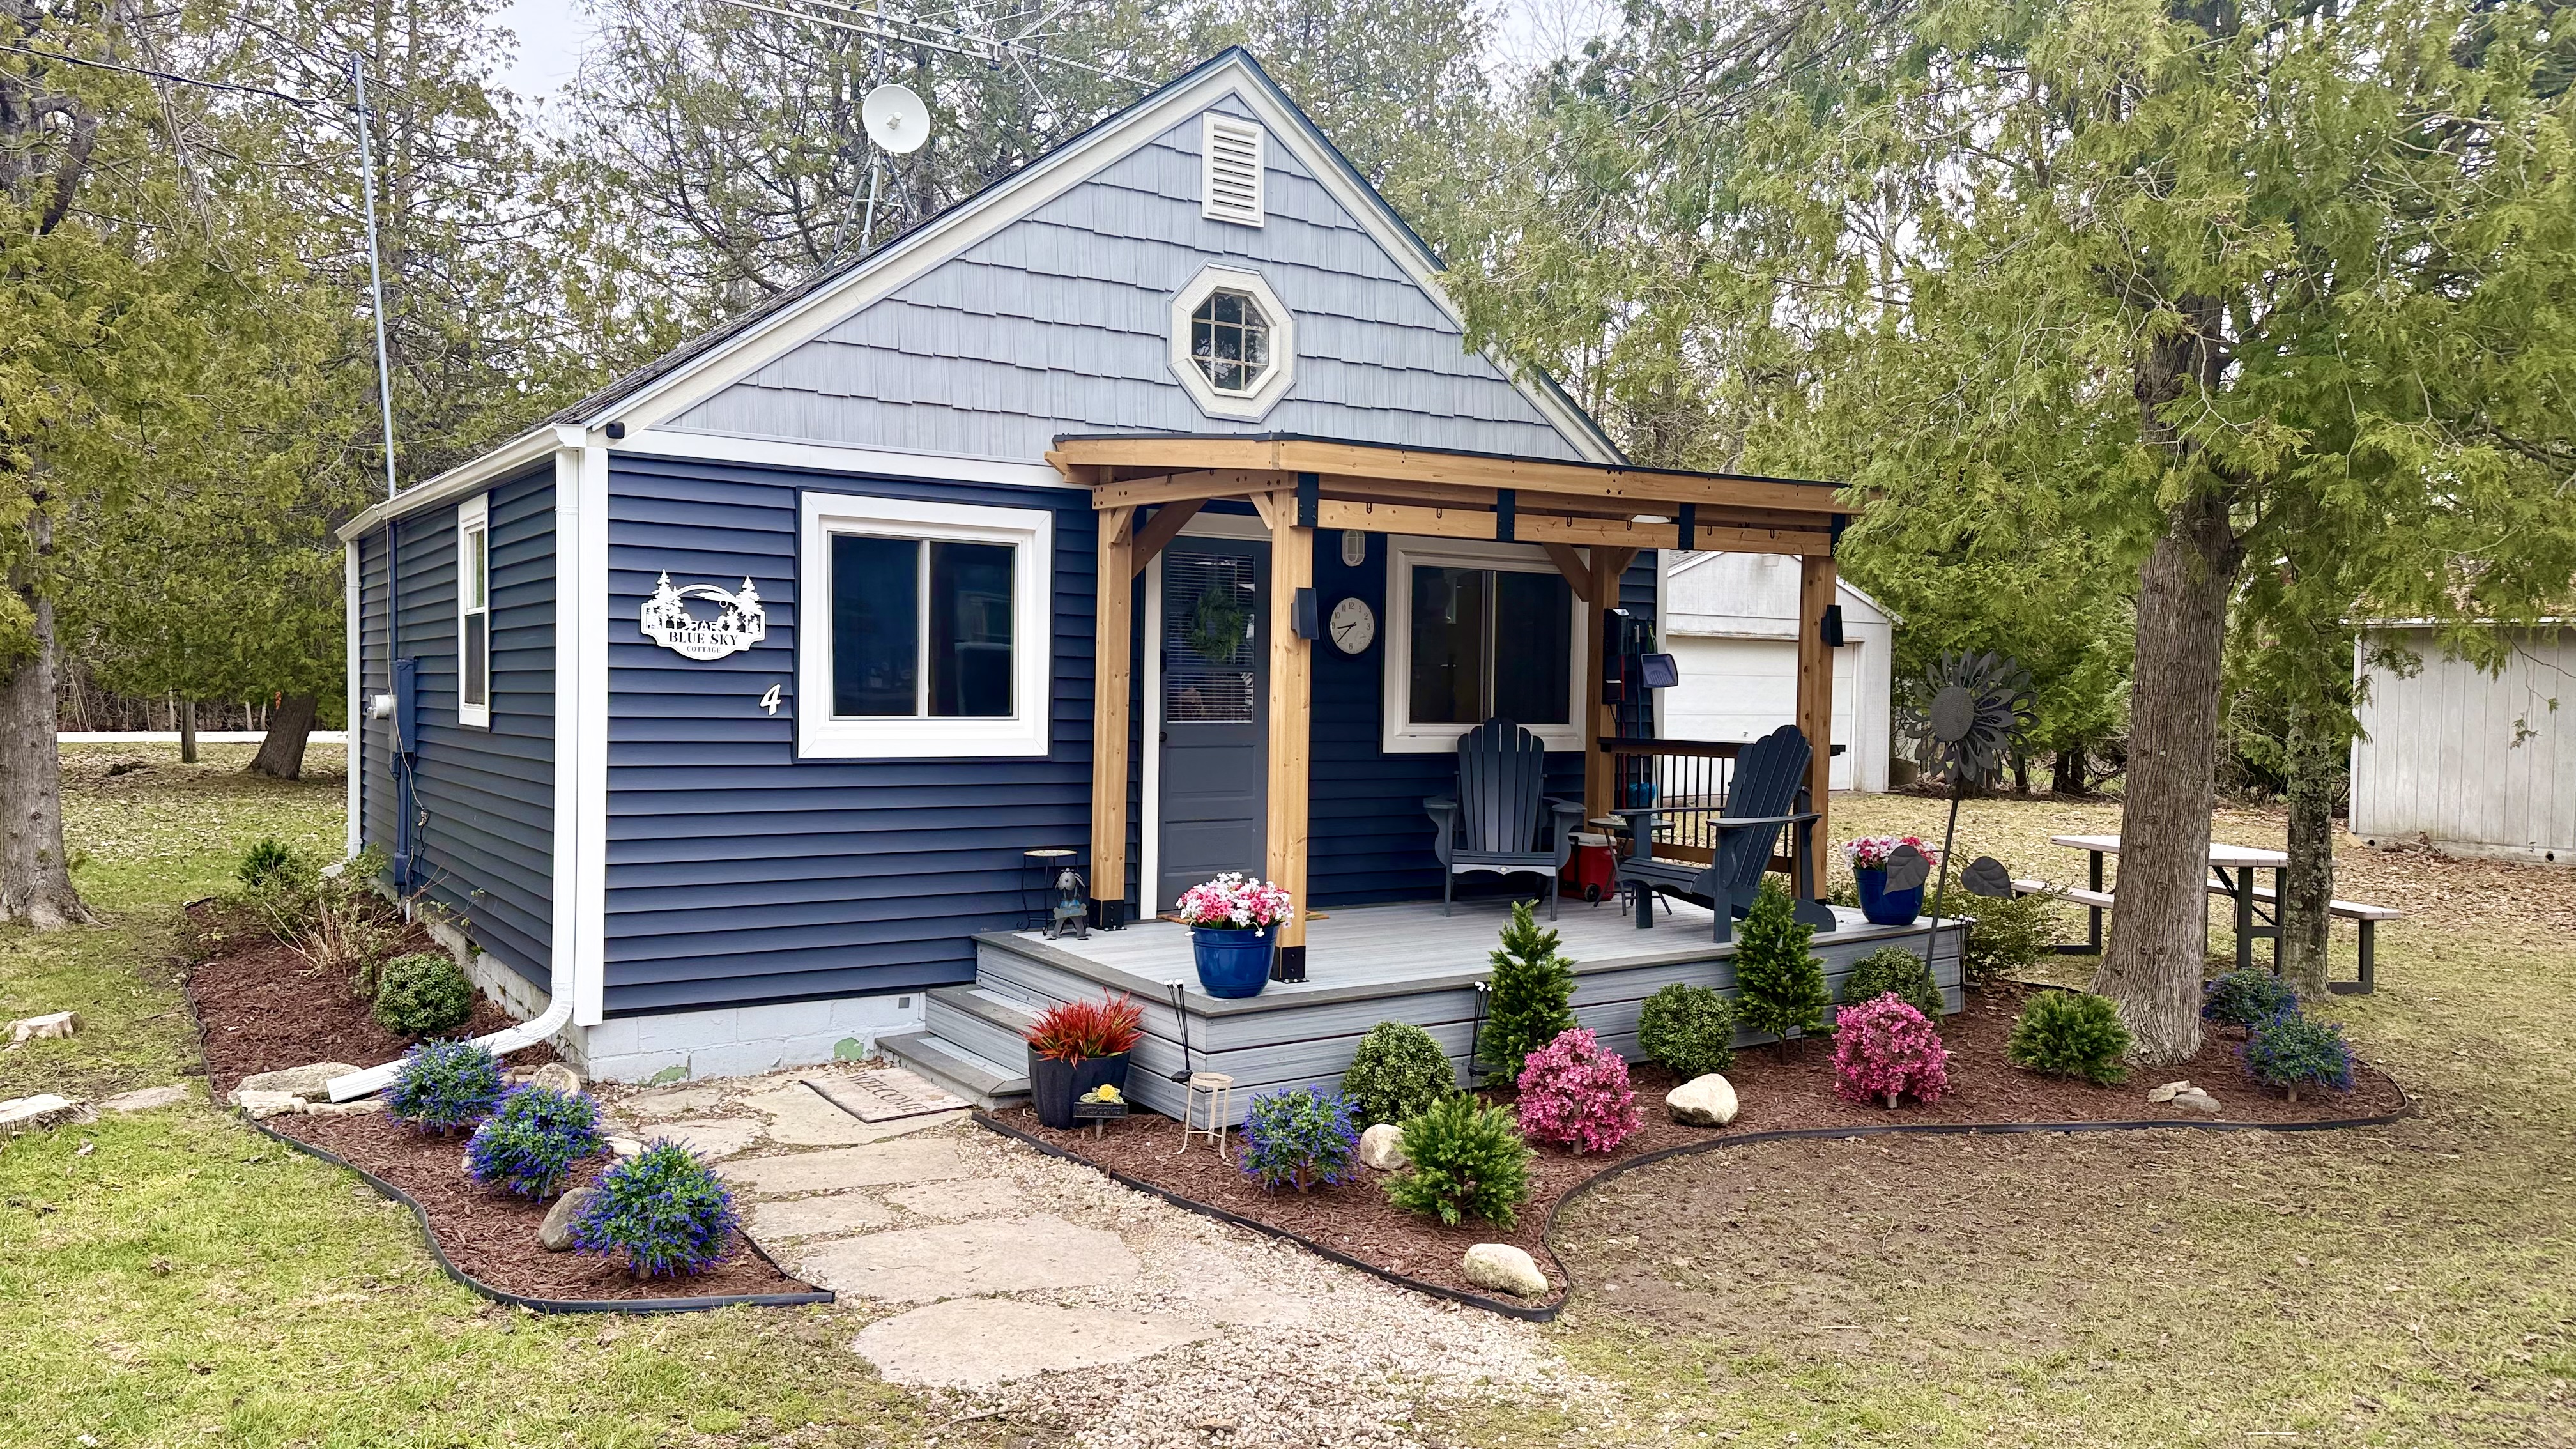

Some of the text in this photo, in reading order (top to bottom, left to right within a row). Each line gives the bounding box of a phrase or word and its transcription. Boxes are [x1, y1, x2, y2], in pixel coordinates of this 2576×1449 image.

[1342, 604, 1346, 613] 11
[1349, 602, 1354, 610] 12
[1358, 605, 1361, 613] 1
[1364, 613, 1368, 621] 2
[1331, 622, 1336, 630] 9
[669, 631, 739, 646] BLUE SKY
[686, 645, 721, 654] COTTAGE
[1349, 642, 1353, 650] 6
[759, 684, 781, 716] 4
